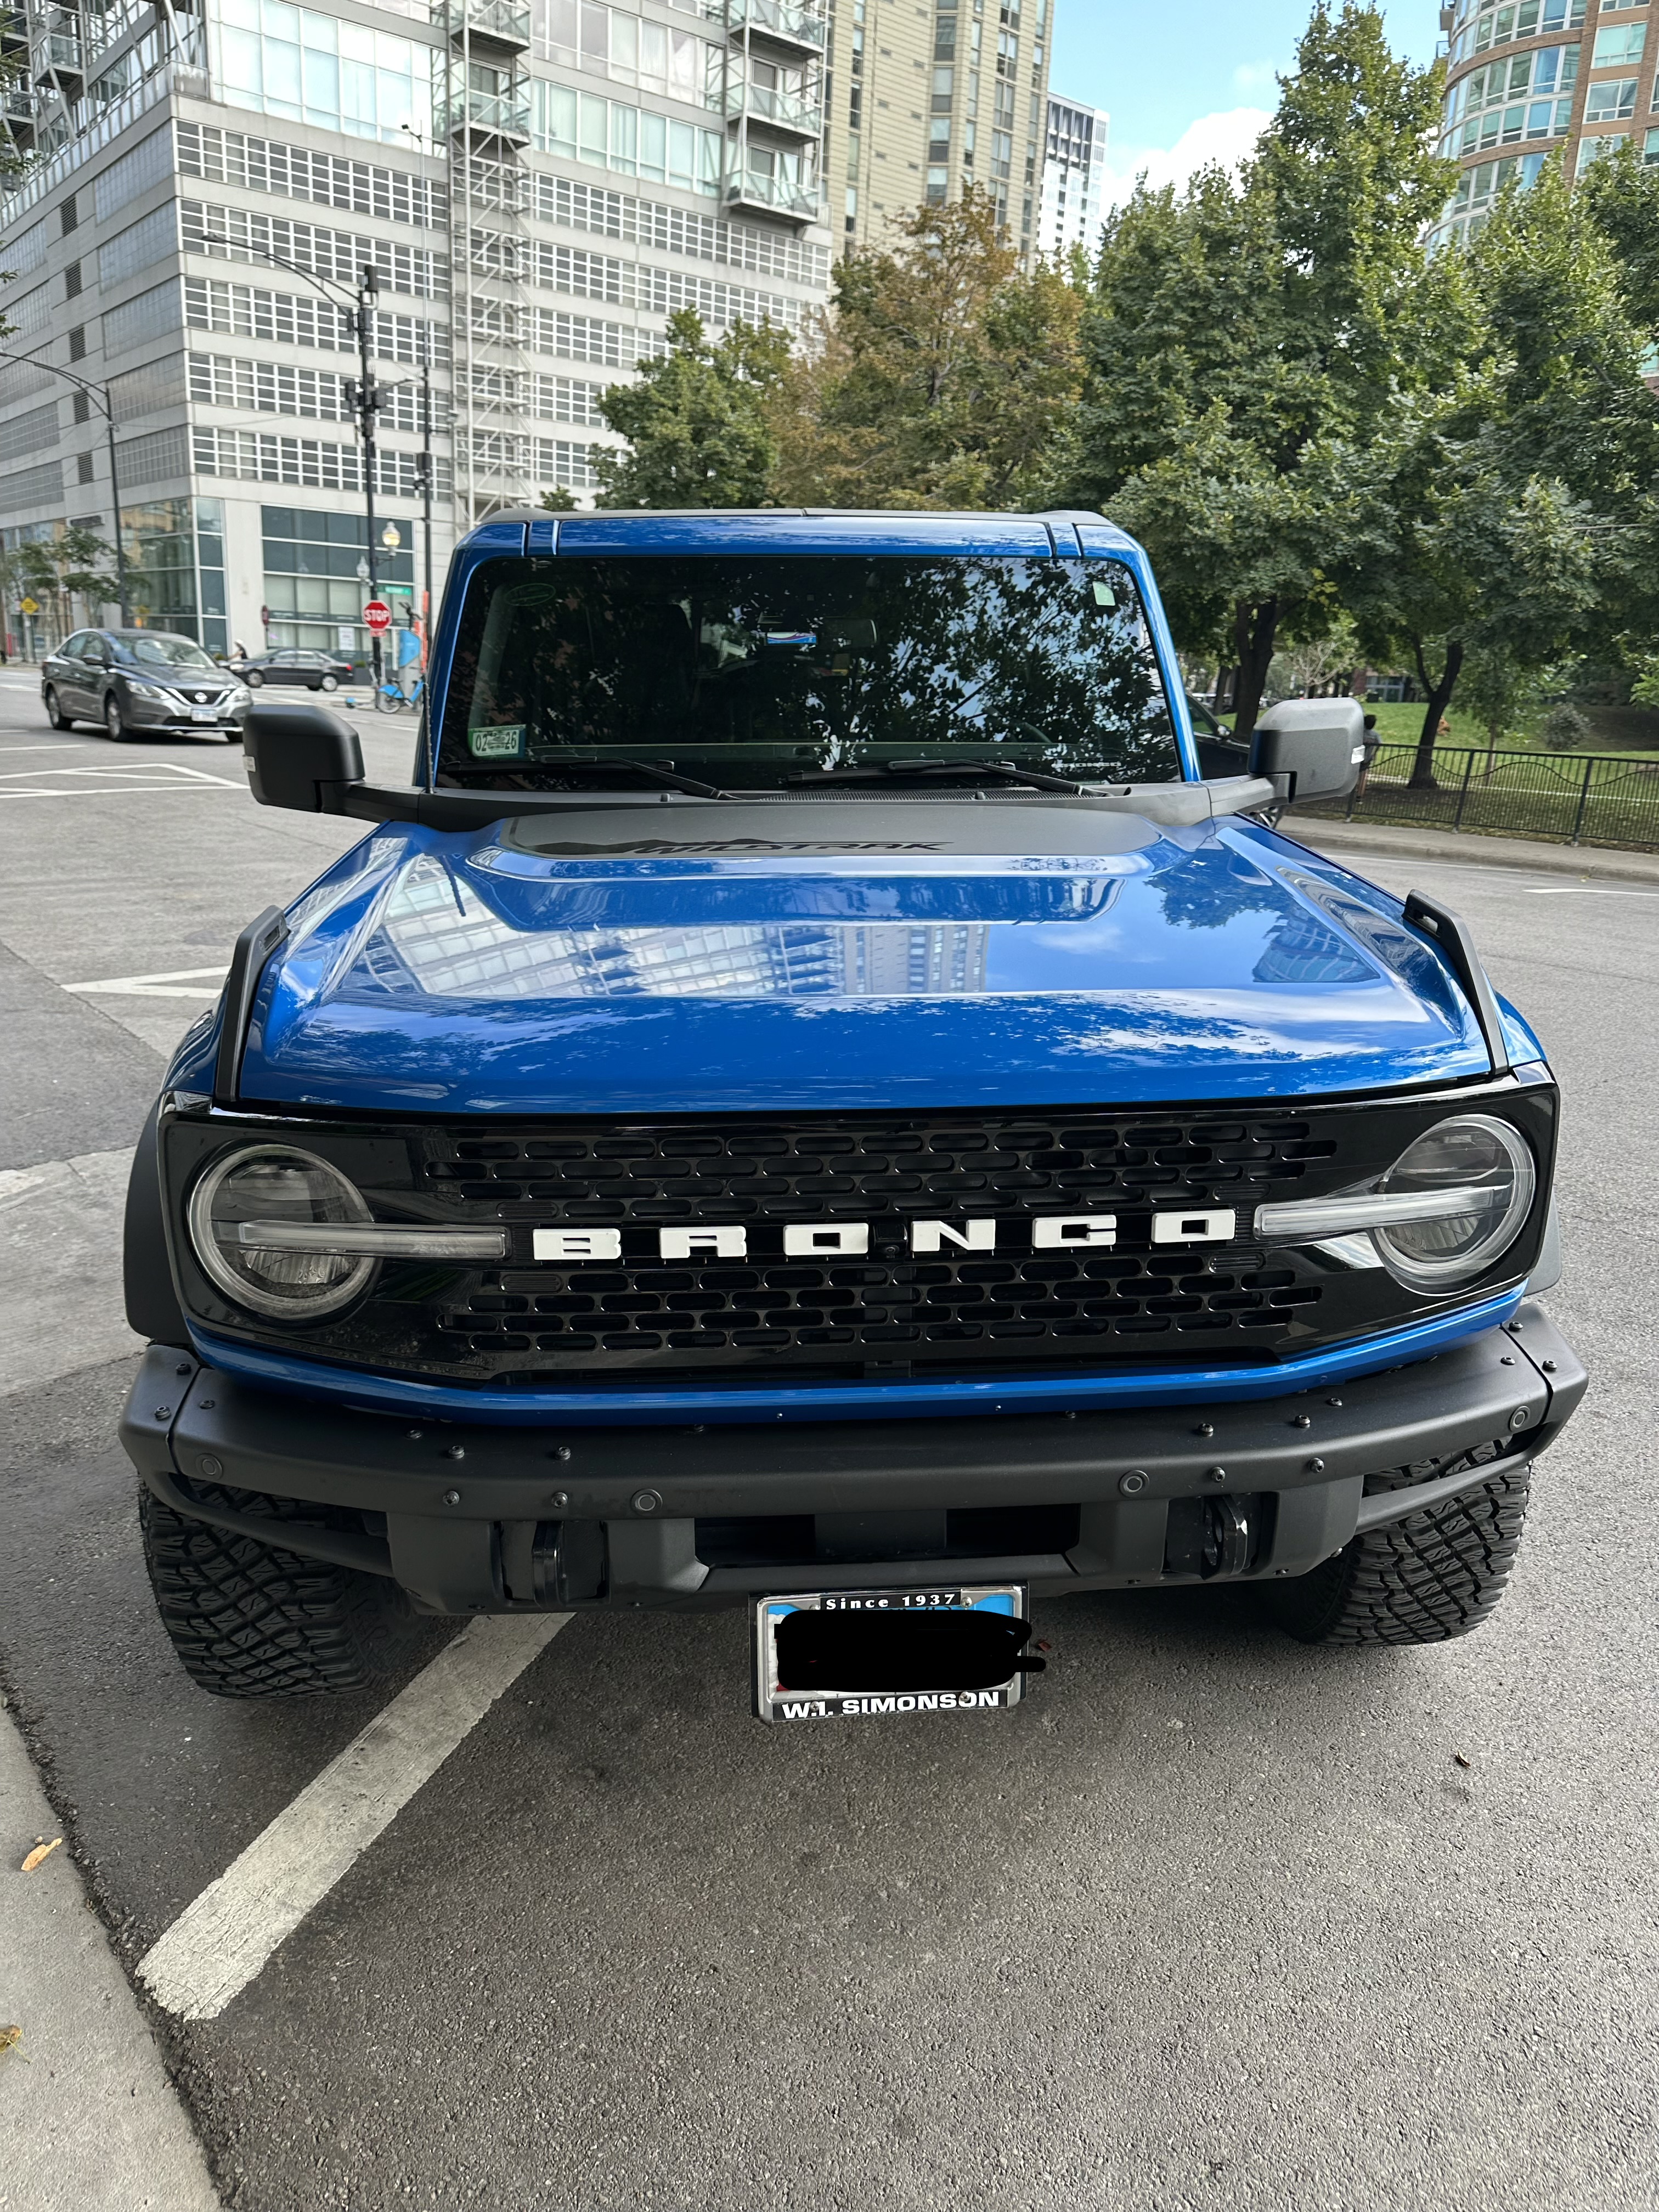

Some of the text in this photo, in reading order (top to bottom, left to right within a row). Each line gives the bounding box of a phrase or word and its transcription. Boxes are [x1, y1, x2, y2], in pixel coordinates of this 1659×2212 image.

[364, 609, 390, 622] STOP
[631, 843, 945, 854] WILDTRAK
[533, 1209, 1236, 1260] BRONCO
[826, 1594, 955, 1610] Since 1937
[842, 1691, 999, 1714] SIMONSON
